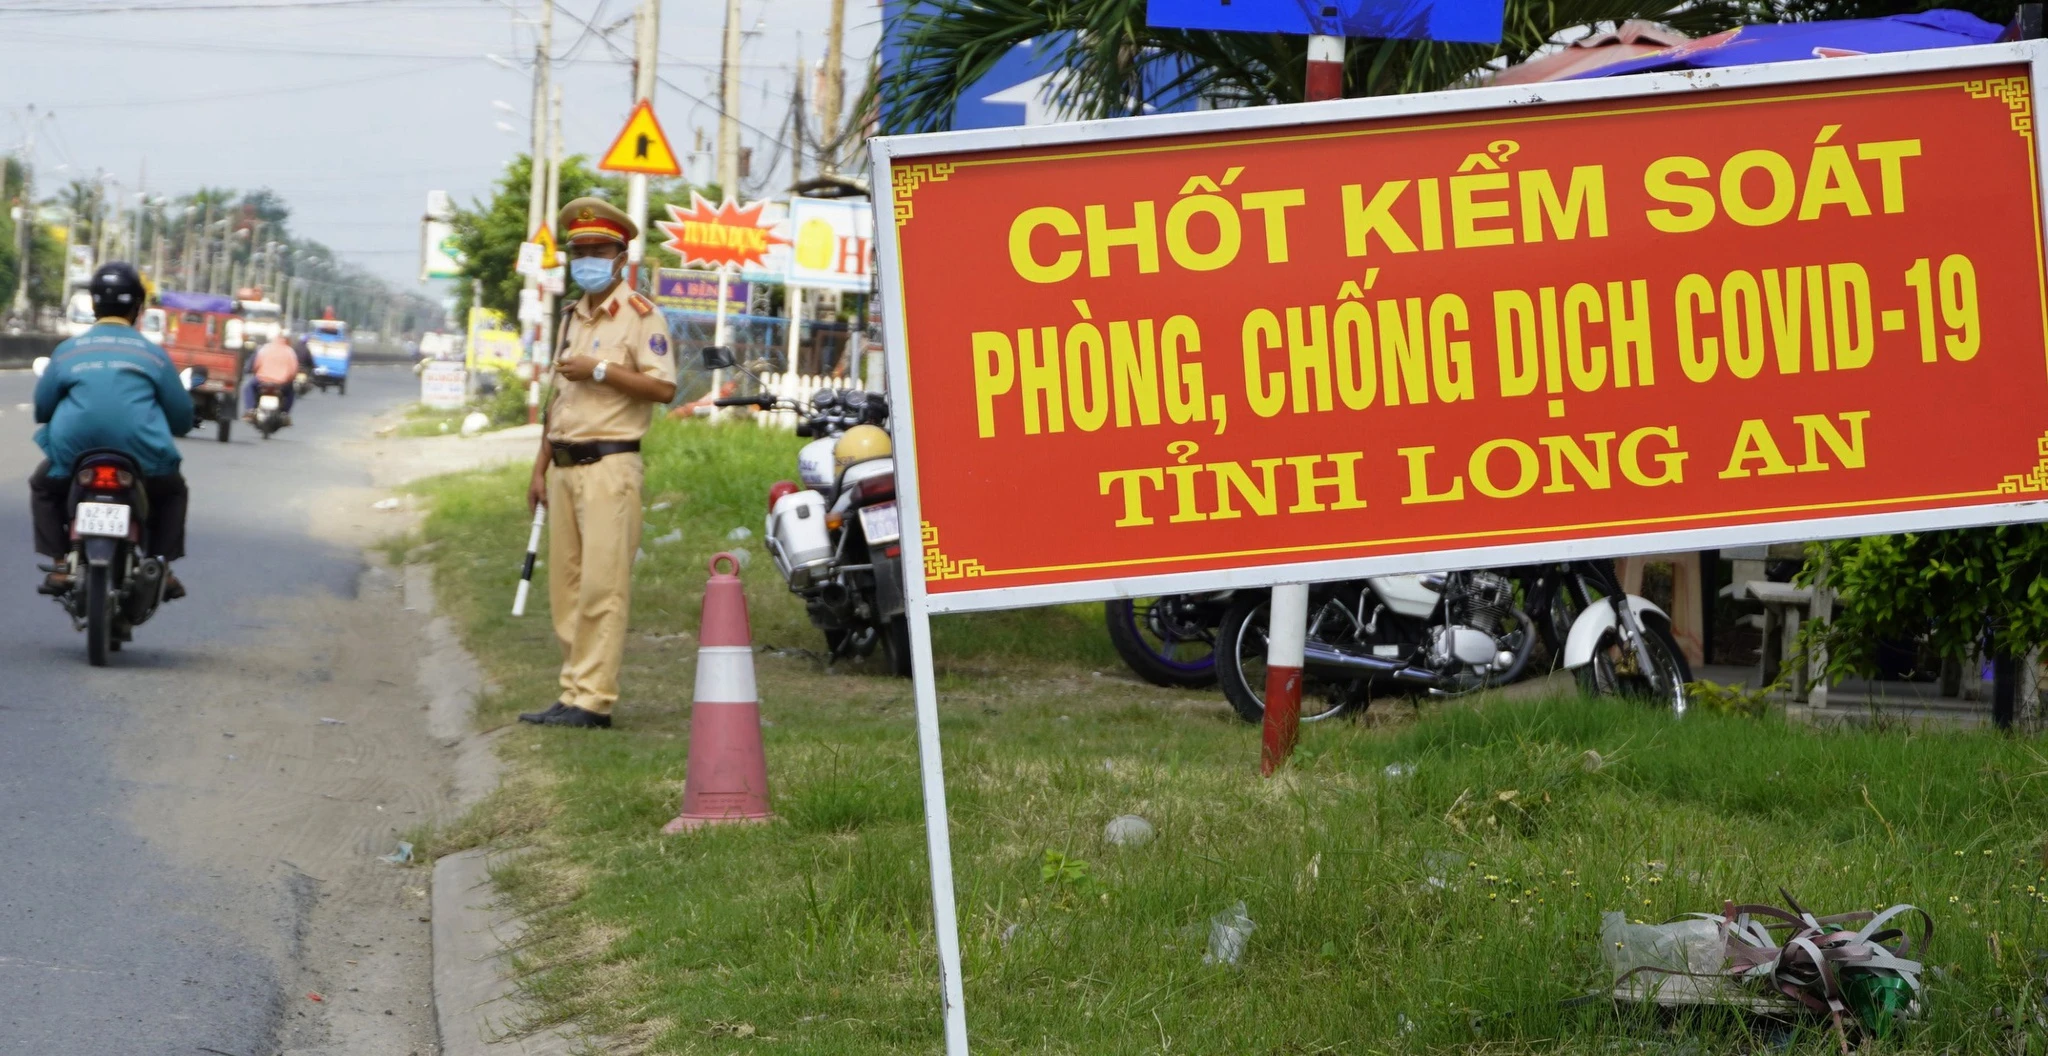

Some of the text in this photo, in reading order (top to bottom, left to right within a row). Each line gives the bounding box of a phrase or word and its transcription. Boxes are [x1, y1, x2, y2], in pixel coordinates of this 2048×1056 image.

[837, 236, 873, 275] H
[1010, 125, 1921, 283] CHỐT KIỂM SOÁT
[972, 254, 1981, 438] PHÒNG, CHỐNG DỊCH COVID-19
[1100, 411, 1870, 527] TỈNH LONG AN
